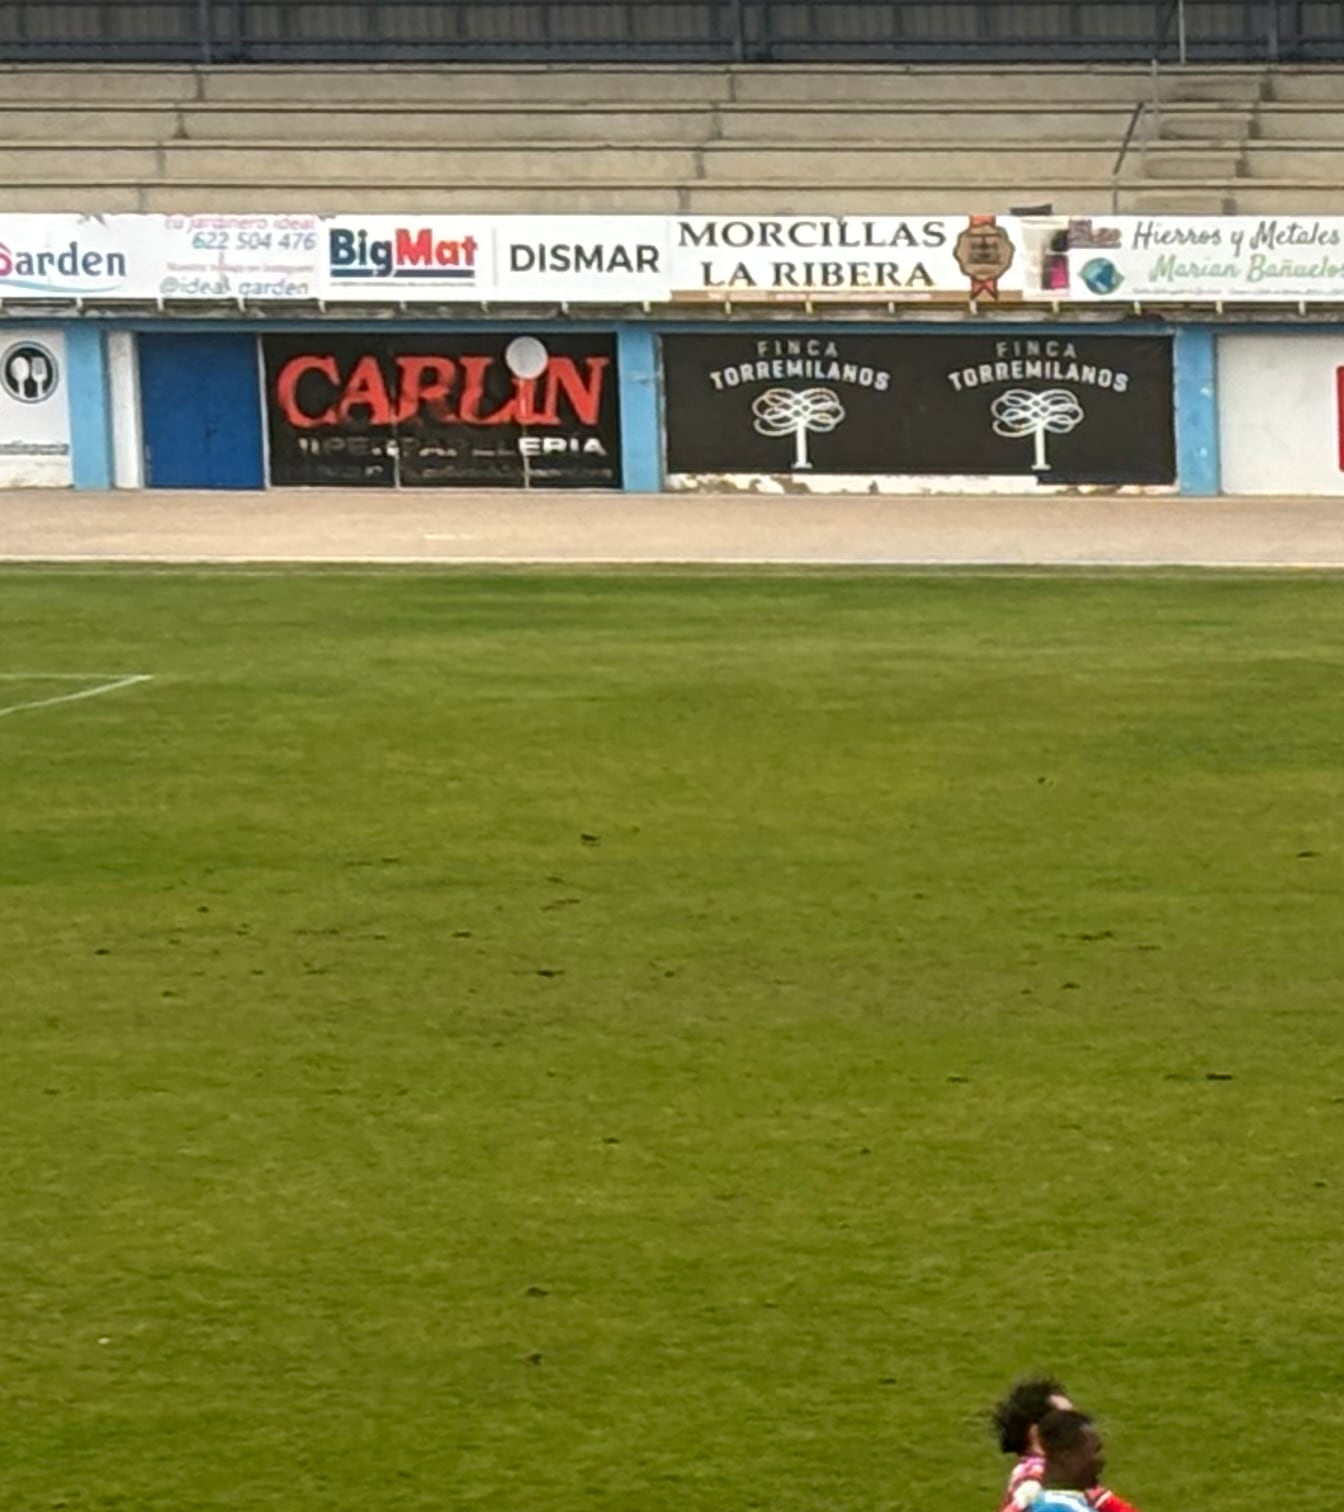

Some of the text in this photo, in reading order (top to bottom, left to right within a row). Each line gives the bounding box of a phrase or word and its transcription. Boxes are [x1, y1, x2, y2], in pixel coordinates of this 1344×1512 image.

[192, 231, 229, 249] 622
[236, 231, 272, 250] 504
[677, 220, 947, 249] MORCILLAS
[1132, 220, 1341, 257] Hierros y Metales
[329, 227, 478, 276] BigMat
[509, 243, 660, 273] DISMAR
[702, 261, 935, 288] LA RIBERA
[757, 340, 838, 358] FINCA
[996, 340, 1077, 359] FINCA
[710, 360, 890, 392] TORREMILANOS
[948, 361, 1130, 394] TORREMILANOS
